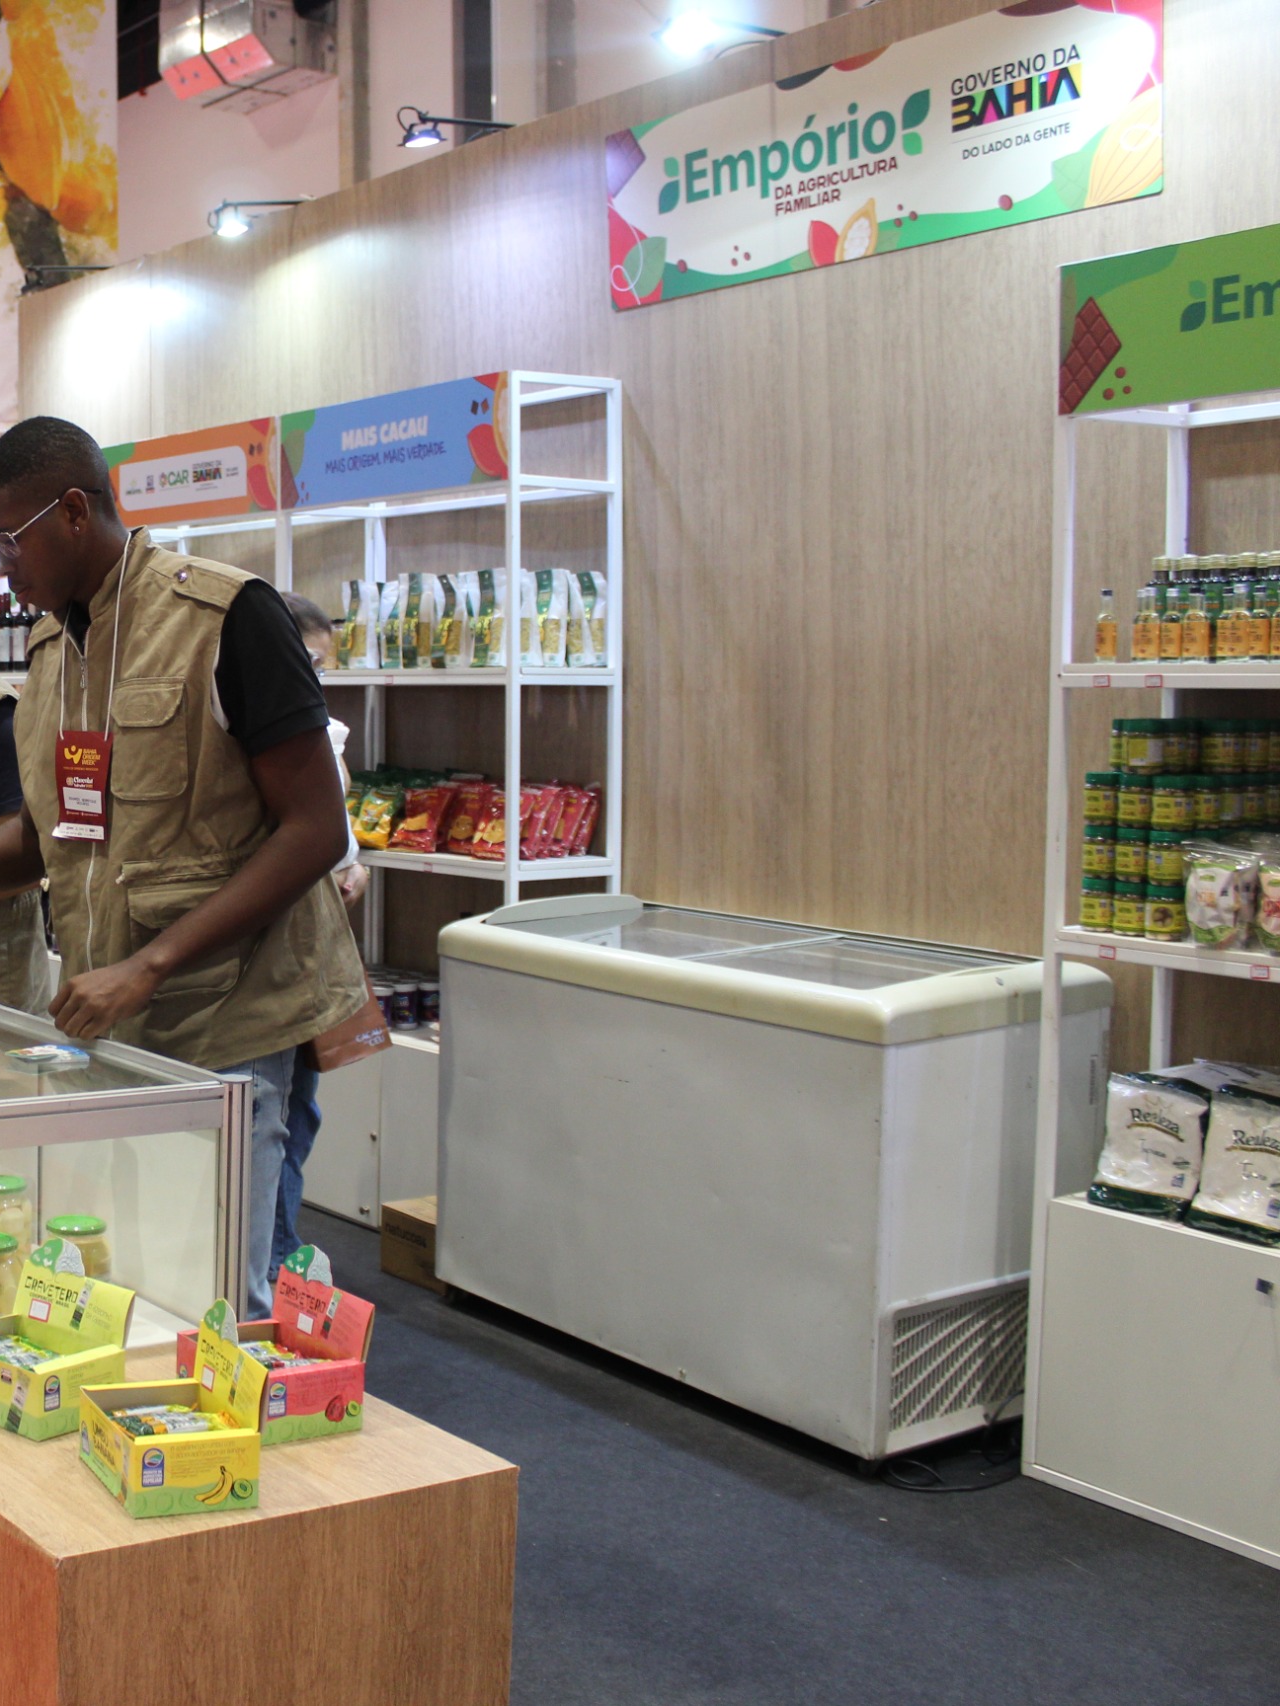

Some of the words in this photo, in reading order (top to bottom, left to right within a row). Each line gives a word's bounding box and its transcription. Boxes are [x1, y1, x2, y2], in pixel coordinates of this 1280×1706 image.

[951, 54, 1046, 96] GOVERNO
[1053, 44, 1081, 67] DA
[951, 65, 1082, 133] BAHIA
[684, 102, 896, 204] Empório
[962, 147, 980, 160] DO
[983, 138, 1013, 155] LADO
[1015, 133, 1031, 147] DA
[1033, 122, 1070, 142] GENTE
[775, 184, 794, 201] DA
[798, 156, 898, 196] AGRICULTURA
[775, 188, 842, 217] FAMILIAR
[341, 425, 378, 452] MAIS
[380, 415, 428, 444] CACAU
[166, 469, 189, 487] CAR
[325, 457, 346, 475] MAIS
[383, 446, 406, 465] MAIS
